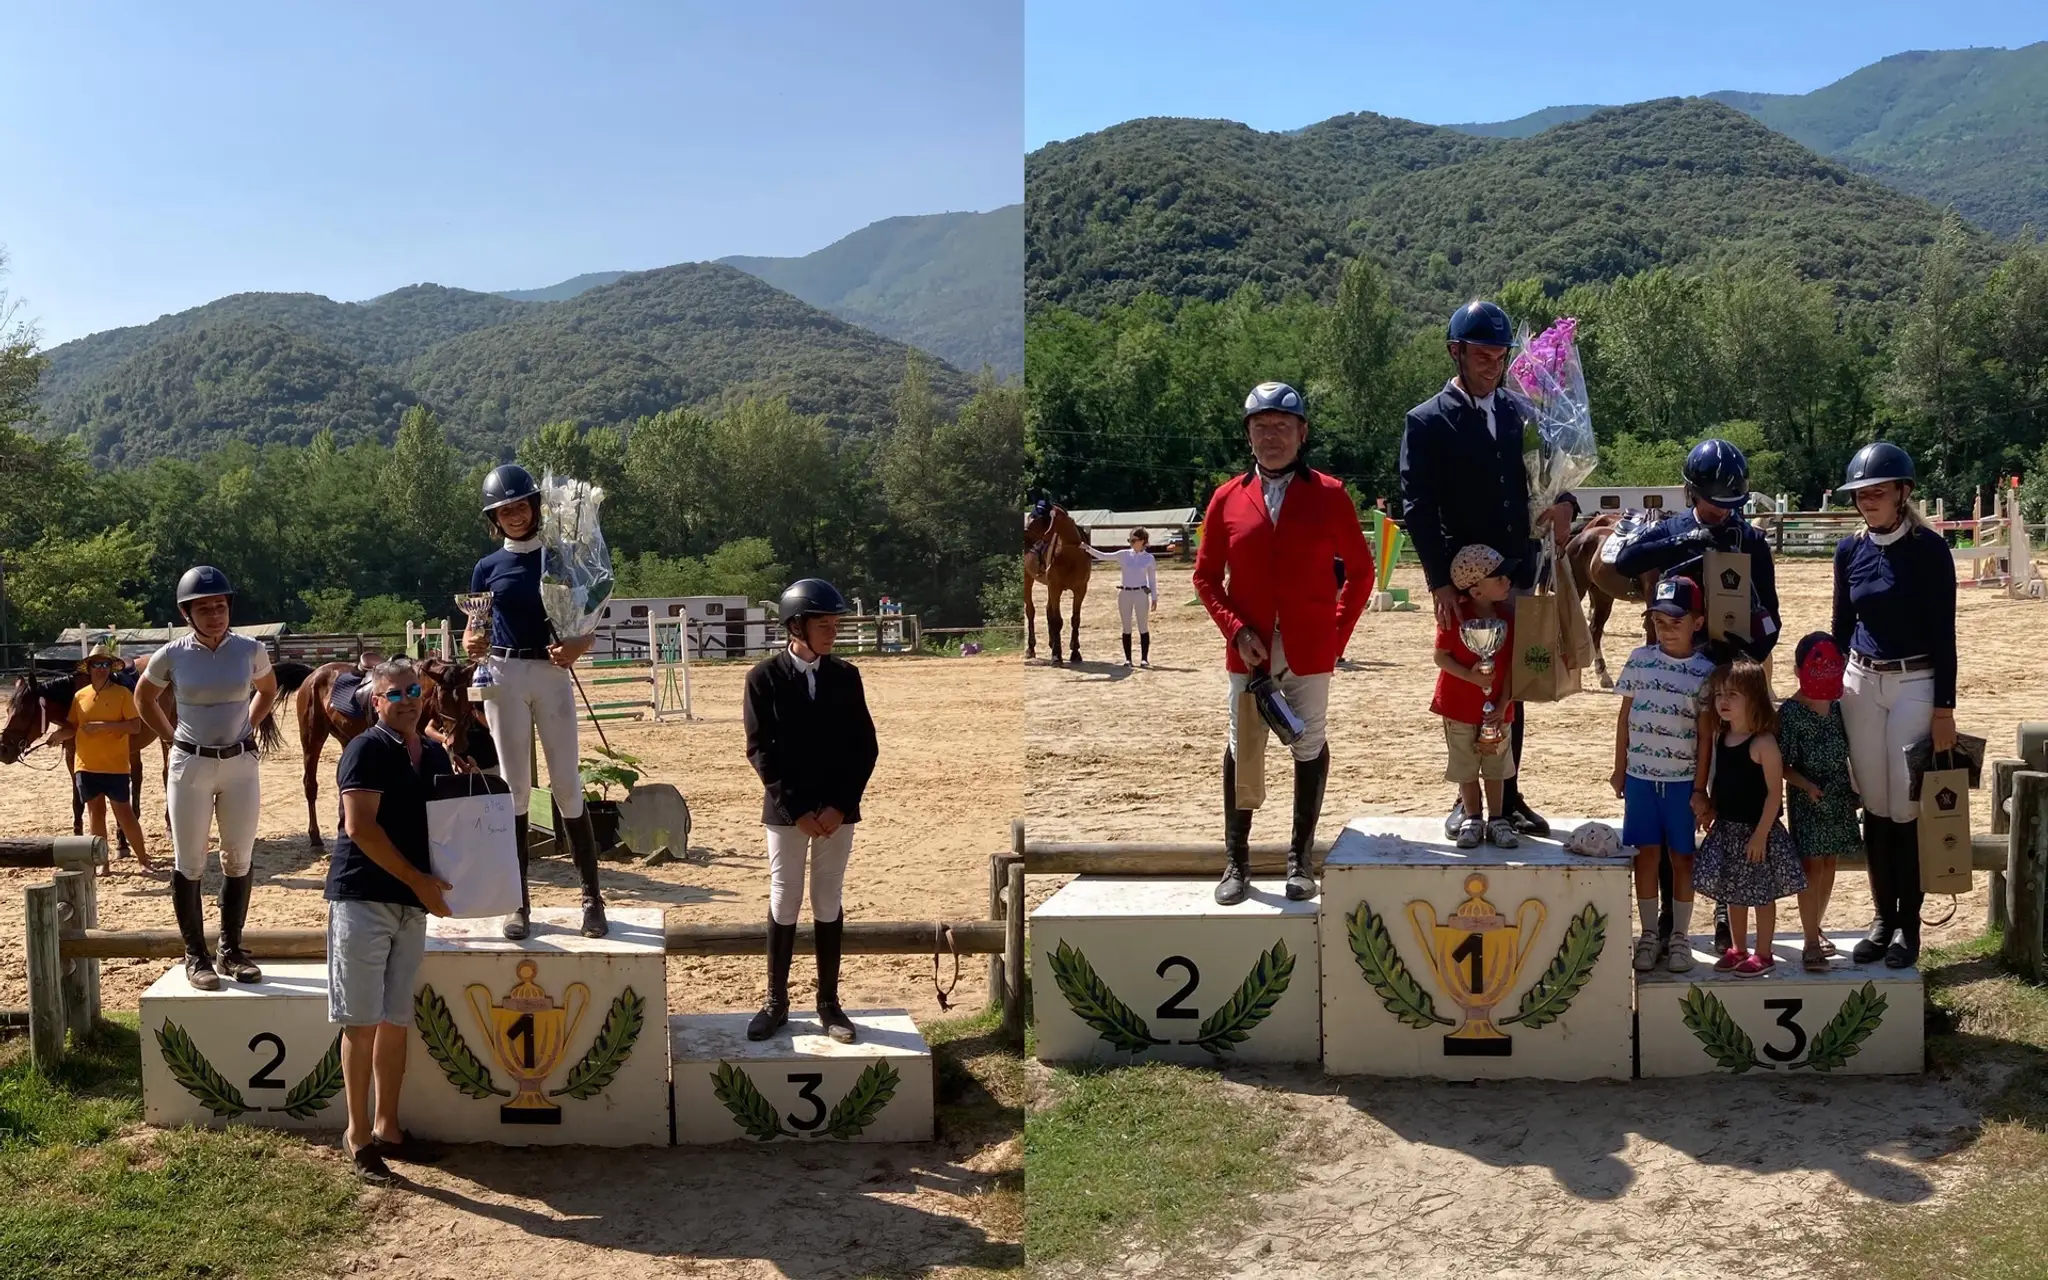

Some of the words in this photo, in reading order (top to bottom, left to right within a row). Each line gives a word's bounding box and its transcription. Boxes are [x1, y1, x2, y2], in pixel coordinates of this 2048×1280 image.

[1156, 956, 1199, 1019] 2
[1452, 933, 1484, 994] 1
[507, 1013, 534, 1069] 1
[1763, 999, 1804, 1062] 3
[248, 1032, 286, 1089] 2
[787, 1073, 827, 1131] 3
